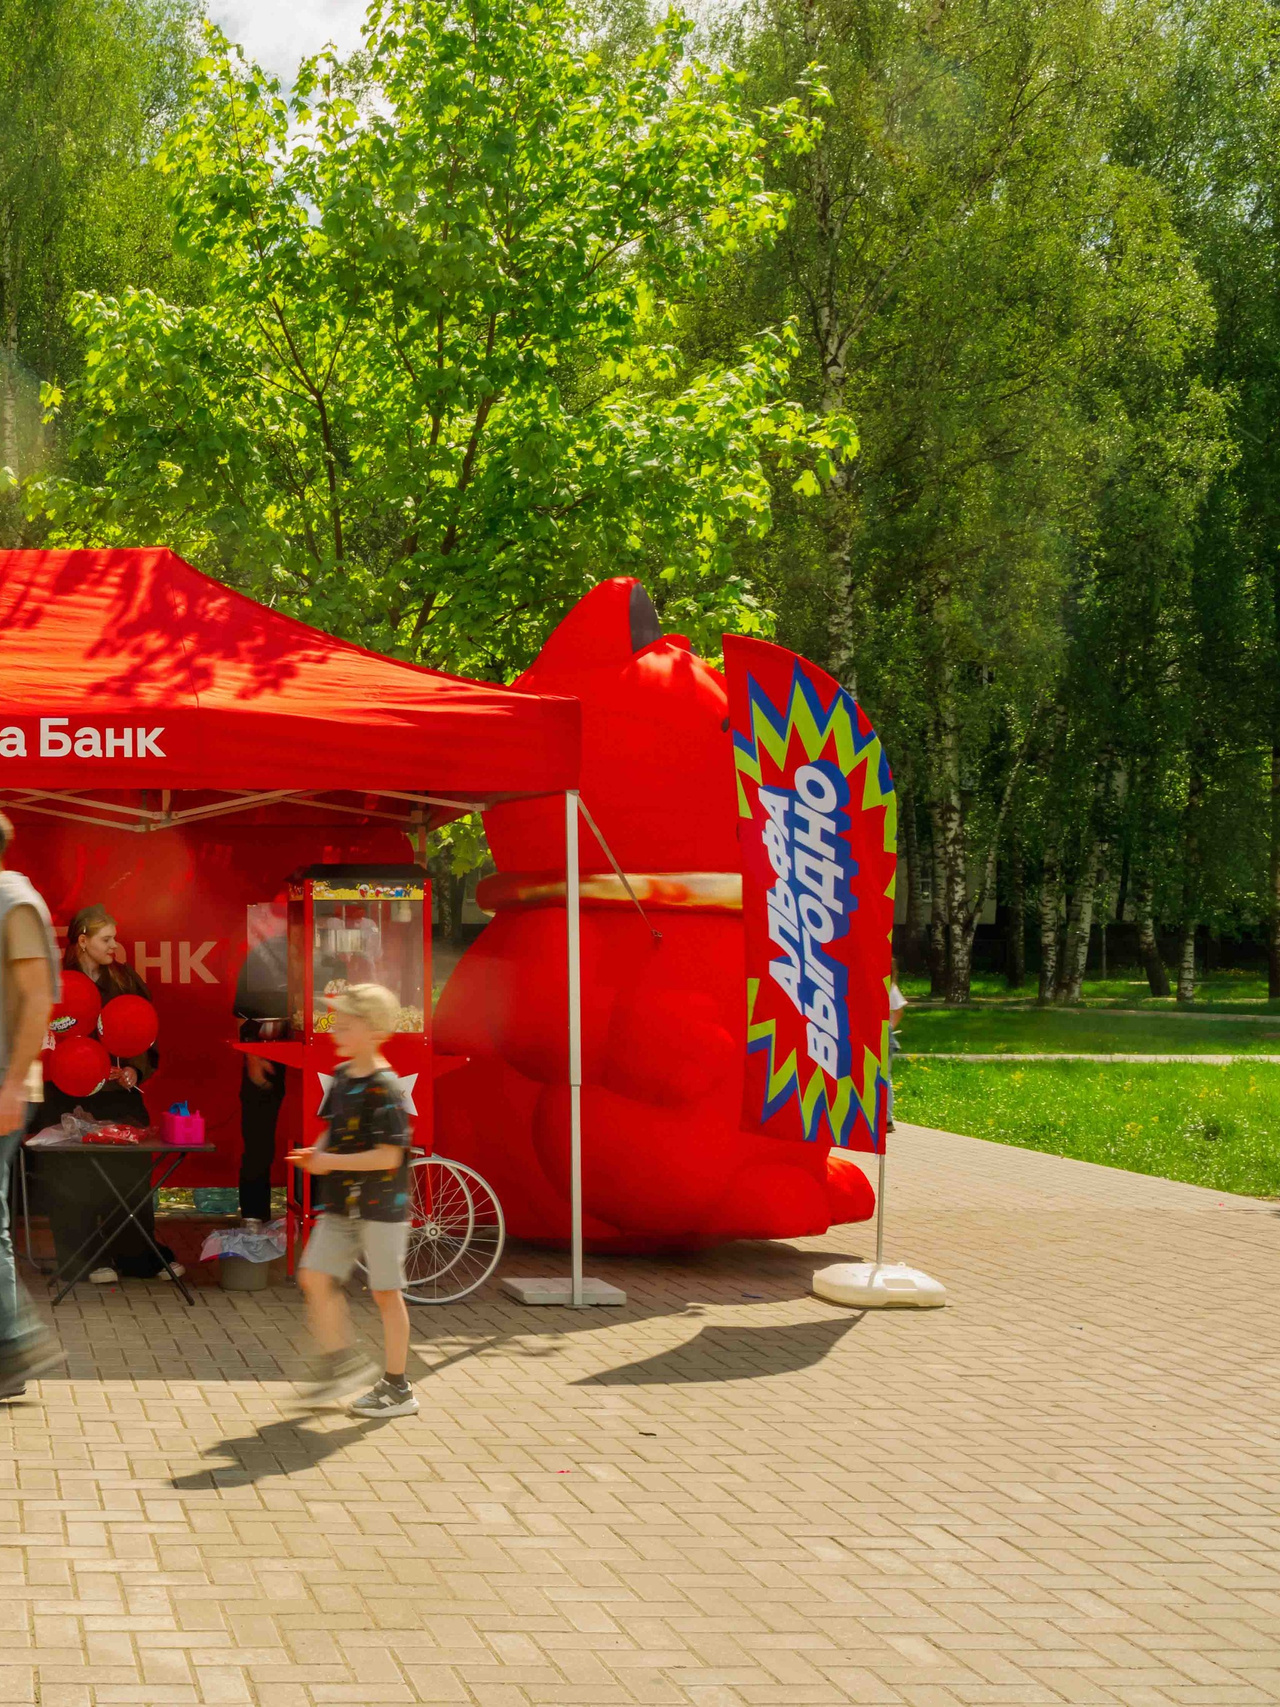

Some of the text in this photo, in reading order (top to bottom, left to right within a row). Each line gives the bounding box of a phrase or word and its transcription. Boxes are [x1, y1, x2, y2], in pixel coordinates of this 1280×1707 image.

[40, 718, 167, 758] Банк
[758, 787, 805, 1016] АЛЬФА
[793, 765, 844, 1080] ВЫГОДНО
